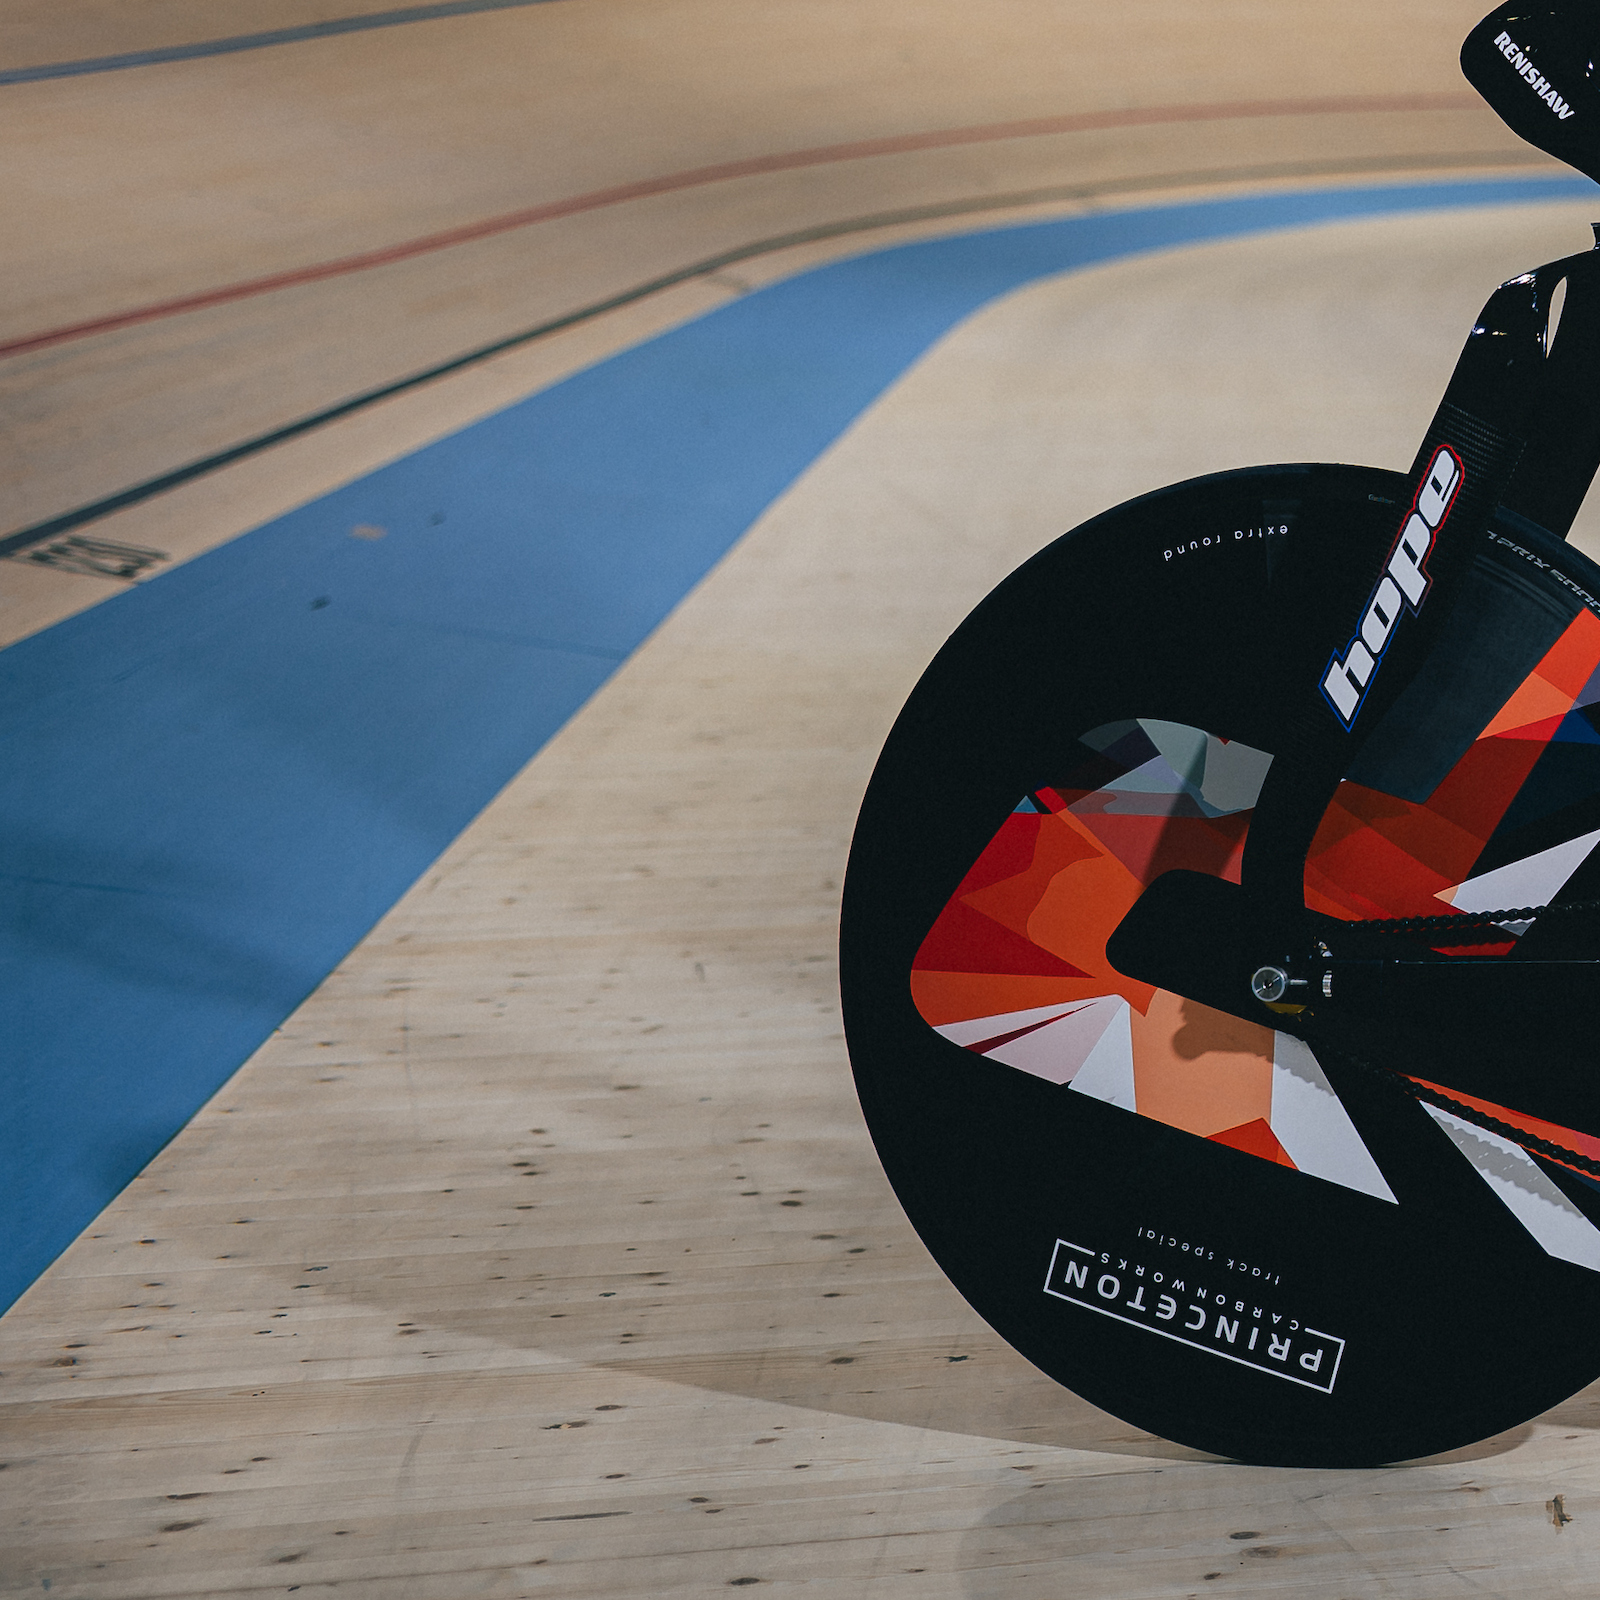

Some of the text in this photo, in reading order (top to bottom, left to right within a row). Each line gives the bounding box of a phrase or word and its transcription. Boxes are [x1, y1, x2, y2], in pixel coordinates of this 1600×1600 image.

[1493, 31, 1575, 120] RENISHAW
[1163, 525, 1288, 561] extra round
[1323, 450, 1460, 721] hope
[1100, 1252, 1299, 1331] CARBONWORKS
[1137, 1226, 1281, 1286] track special
[1064, 1260, 1324, 1373] PRINCETON
